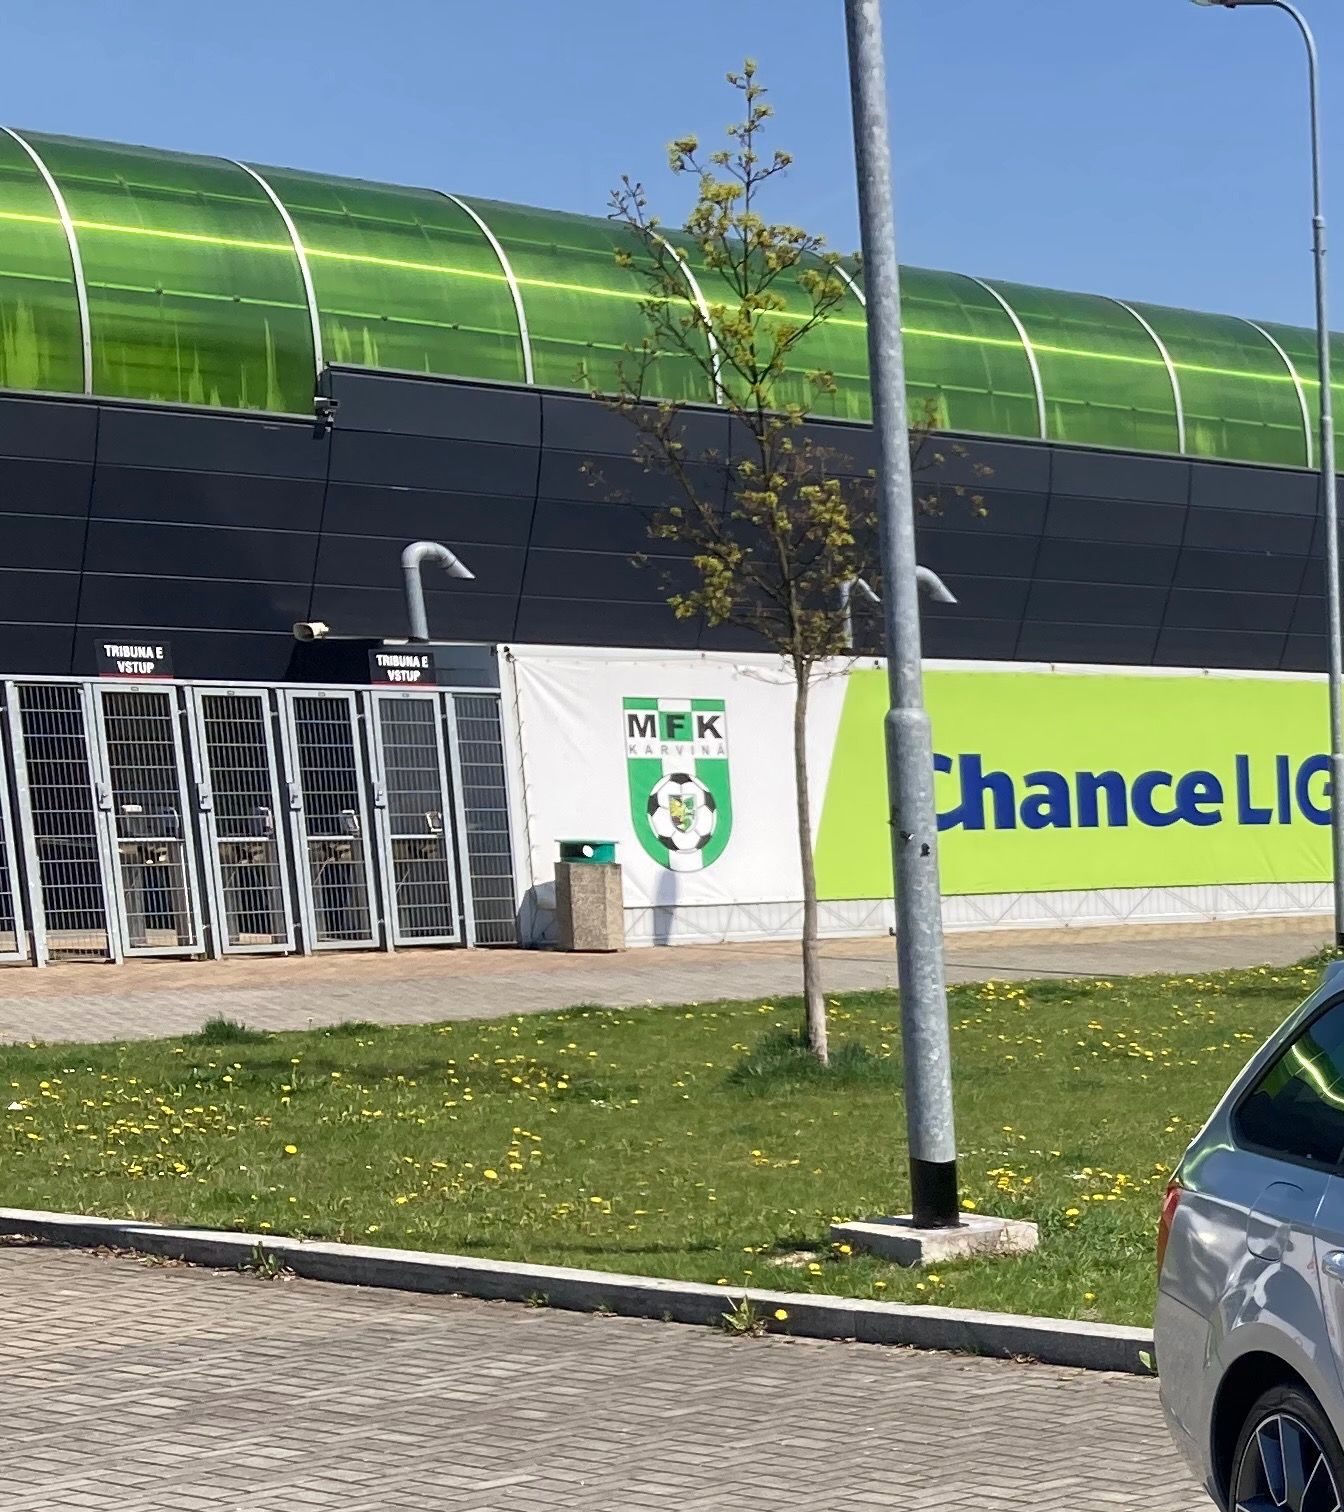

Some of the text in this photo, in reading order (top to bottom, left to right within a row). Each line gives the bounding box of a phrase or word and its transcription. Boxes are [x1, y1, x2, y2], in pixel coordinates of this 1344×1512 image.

[104, 644, 164, 660] TRIBUNA E
[116, 660, 155, 674] VSTUP
[376, 654, 429, 668] TRIBUNA E
[387, 669, 421, 682] VSTUP
[627, 713, 723, 739] MFK
